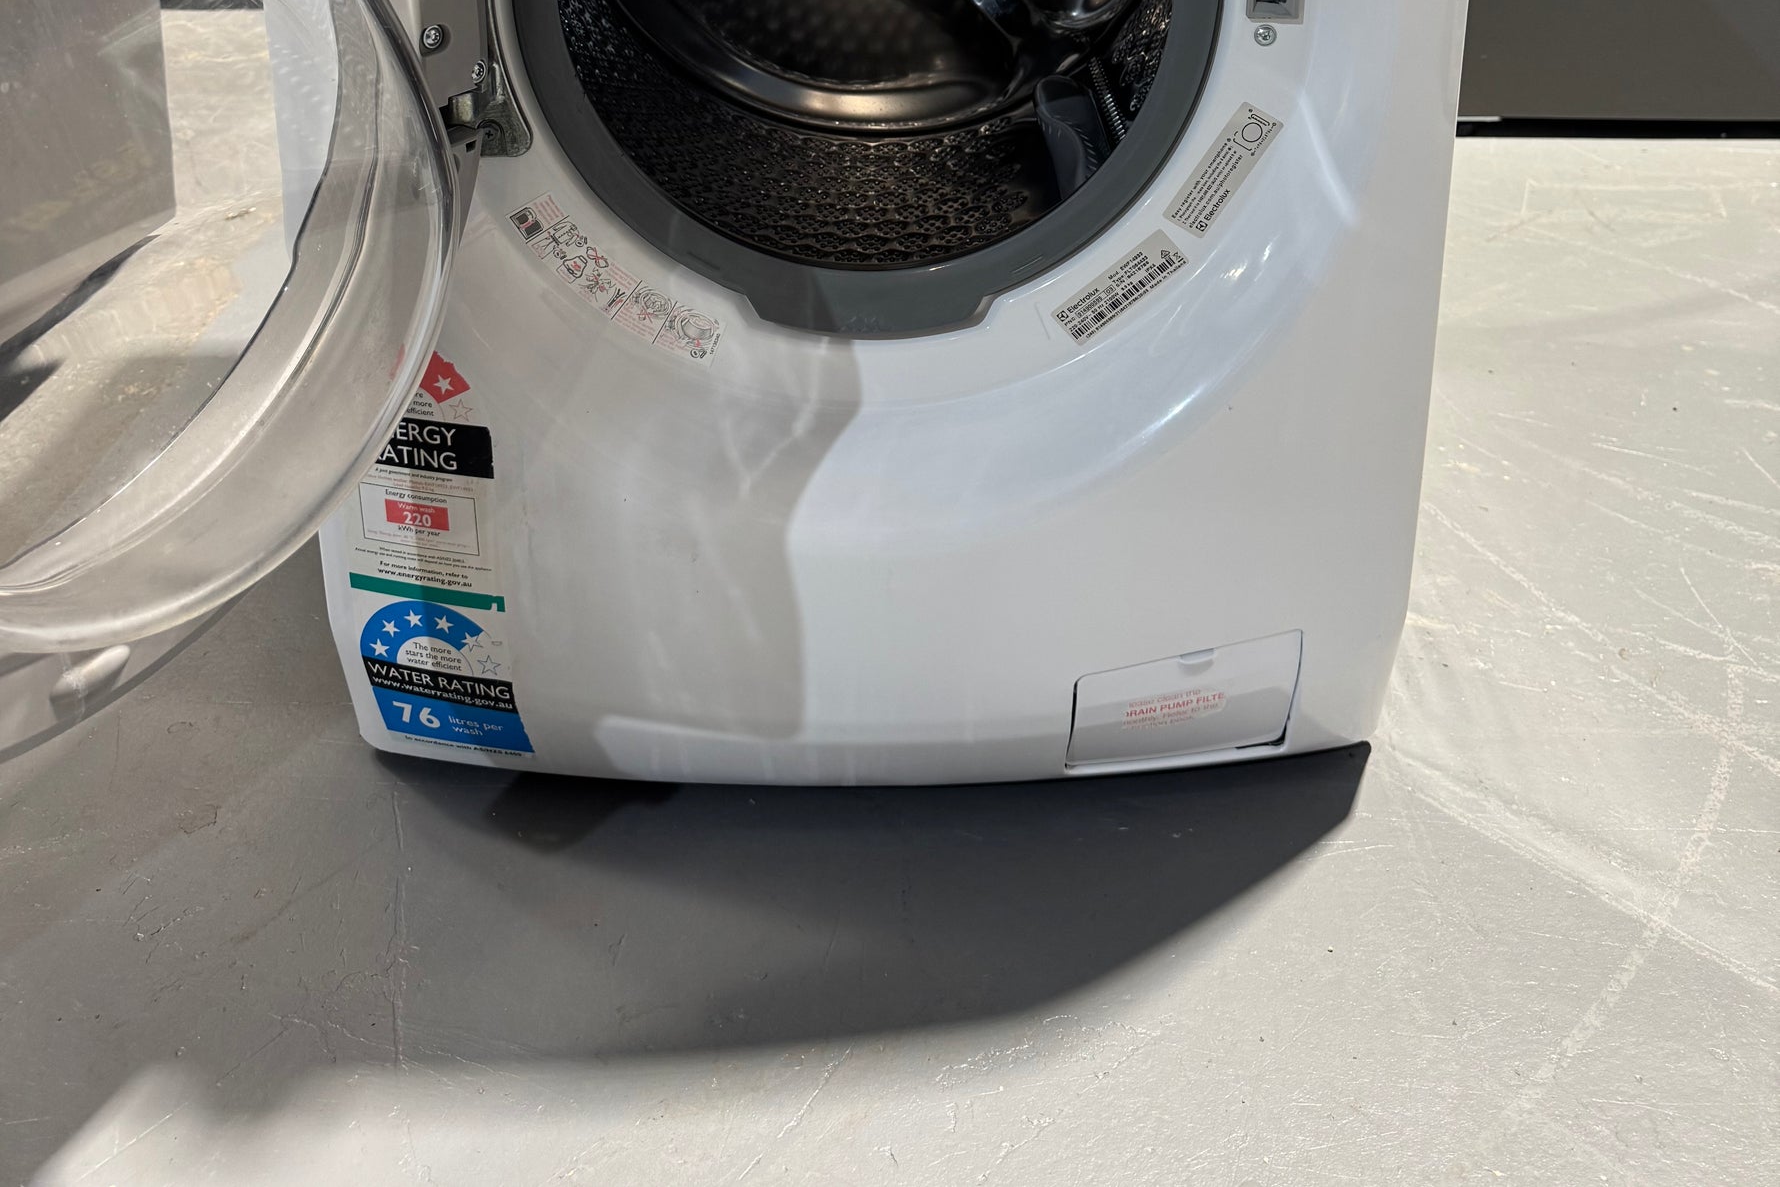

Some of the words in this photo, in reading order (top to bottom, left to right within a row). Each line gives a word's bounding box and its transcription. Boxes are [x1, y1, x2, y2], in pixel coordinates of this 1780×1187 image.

[1203, 187, 1230, 221] Electrolux
[1067, 286, 1099, 313] Electrolux
[406, 407, 435, 417] efficient
[413, 400, 433, 408] more
[392, 422, 457, 446] ERGY
[378, 444, 458, 471] ATING
[384, 488, 406, 499] Energy
[407, 493, 448, 504] consumption
[398, 502, 418, 511] Warm
[419, 505, 436, 514] wash
[403, 511, 432, 527] 220
[398, 525, 413, 533] kWh
[414, 527, 426, 535] per
[426, 529, 441, 537] year
[377, 568, 472, 588] www.energyrating.gov.au
[405, 649, 424, 659] stars
[425, 651, 439, 661] the
[440, 655, 462, 664] more
[413, 641, 429, 653] The
[430, 646, 452, 655] more
[406, 656, 430, 667] water
[431, 658, 463, 672] efficient
[367, 660, 434, 687] WATER
[438, 677, 511, 700] RATING
[372, 674, 514, 710] www.waterrating.gov.au
[1159, 698, 1193, 712] PUMP
[1195, 692, 1225, 705] FILTE
[391, 700, 441, 730] 76
[448, 715, 479, 728] litres
[483, 722, 504, 733] per
[452, 725, 483, 737] wash
